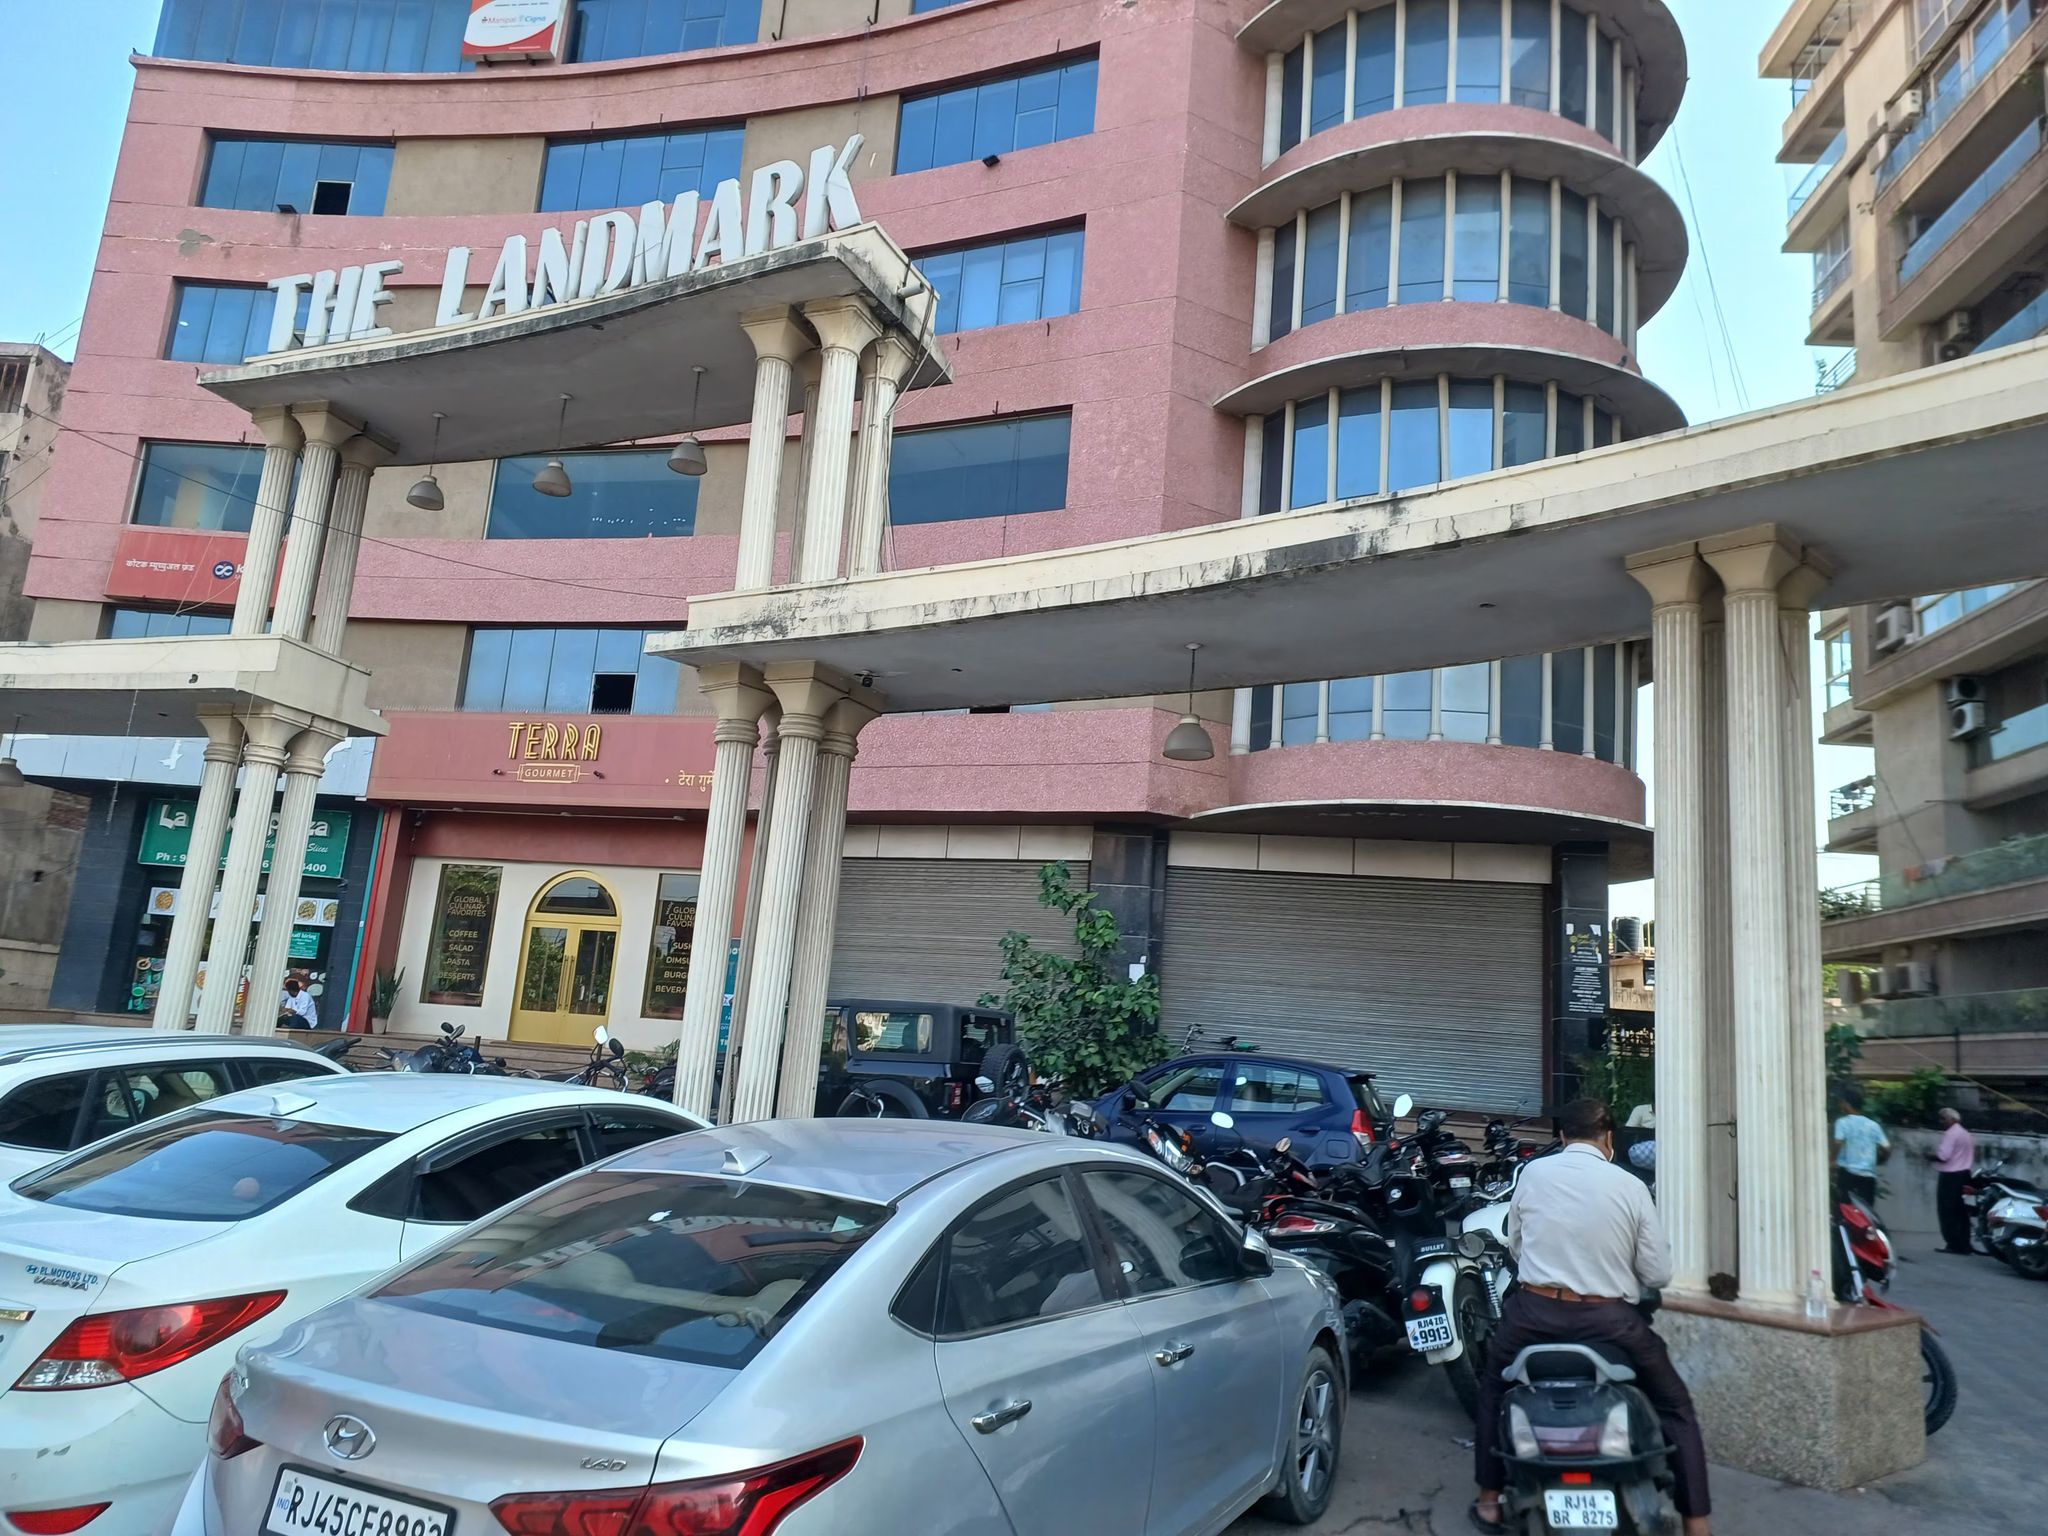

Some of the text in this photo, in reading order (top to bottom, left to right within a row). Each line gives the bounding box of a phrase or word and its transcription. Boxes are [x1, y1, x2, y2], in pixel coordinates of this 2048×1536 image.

[268, 133, 866, 353] THE LANDMARK
[508, 722, 602, 761] TERRA
[524, 767, 573, 779] GOURMET
[678, 769, 695, 786] टेरा
[159, 804, 188, 829] La
[453, 895, 483, 904] GLOBAL
[449, 902, 486, 911] CULINARY
[673, 906, 695, 915] GLOB
[447, 908, 487, 917] FAVORITES
[448, 930, 478, 938] COFFEE
[448, 944, 474, 952] SALAD
[446, 958, 470, 966] PASTA
[439, 972, 476, 981] DESSERTS
[663, 971, 687, 979] BURG
[655, 985, 687, 993] BEVERA
[1420, 1244, 1444, 1253] BULLET
[50, 1267, 81, 1282] MOTORS
[1417, 1318, 1434, 1329] RJ14
[1419, 1326, 1450, 1344] 9913
[277, 1497, 290, 1511] IND
[1564, 1495, 1596, 1509] RJ14
[1553, 1510, 1614, 1525] BR 8275
